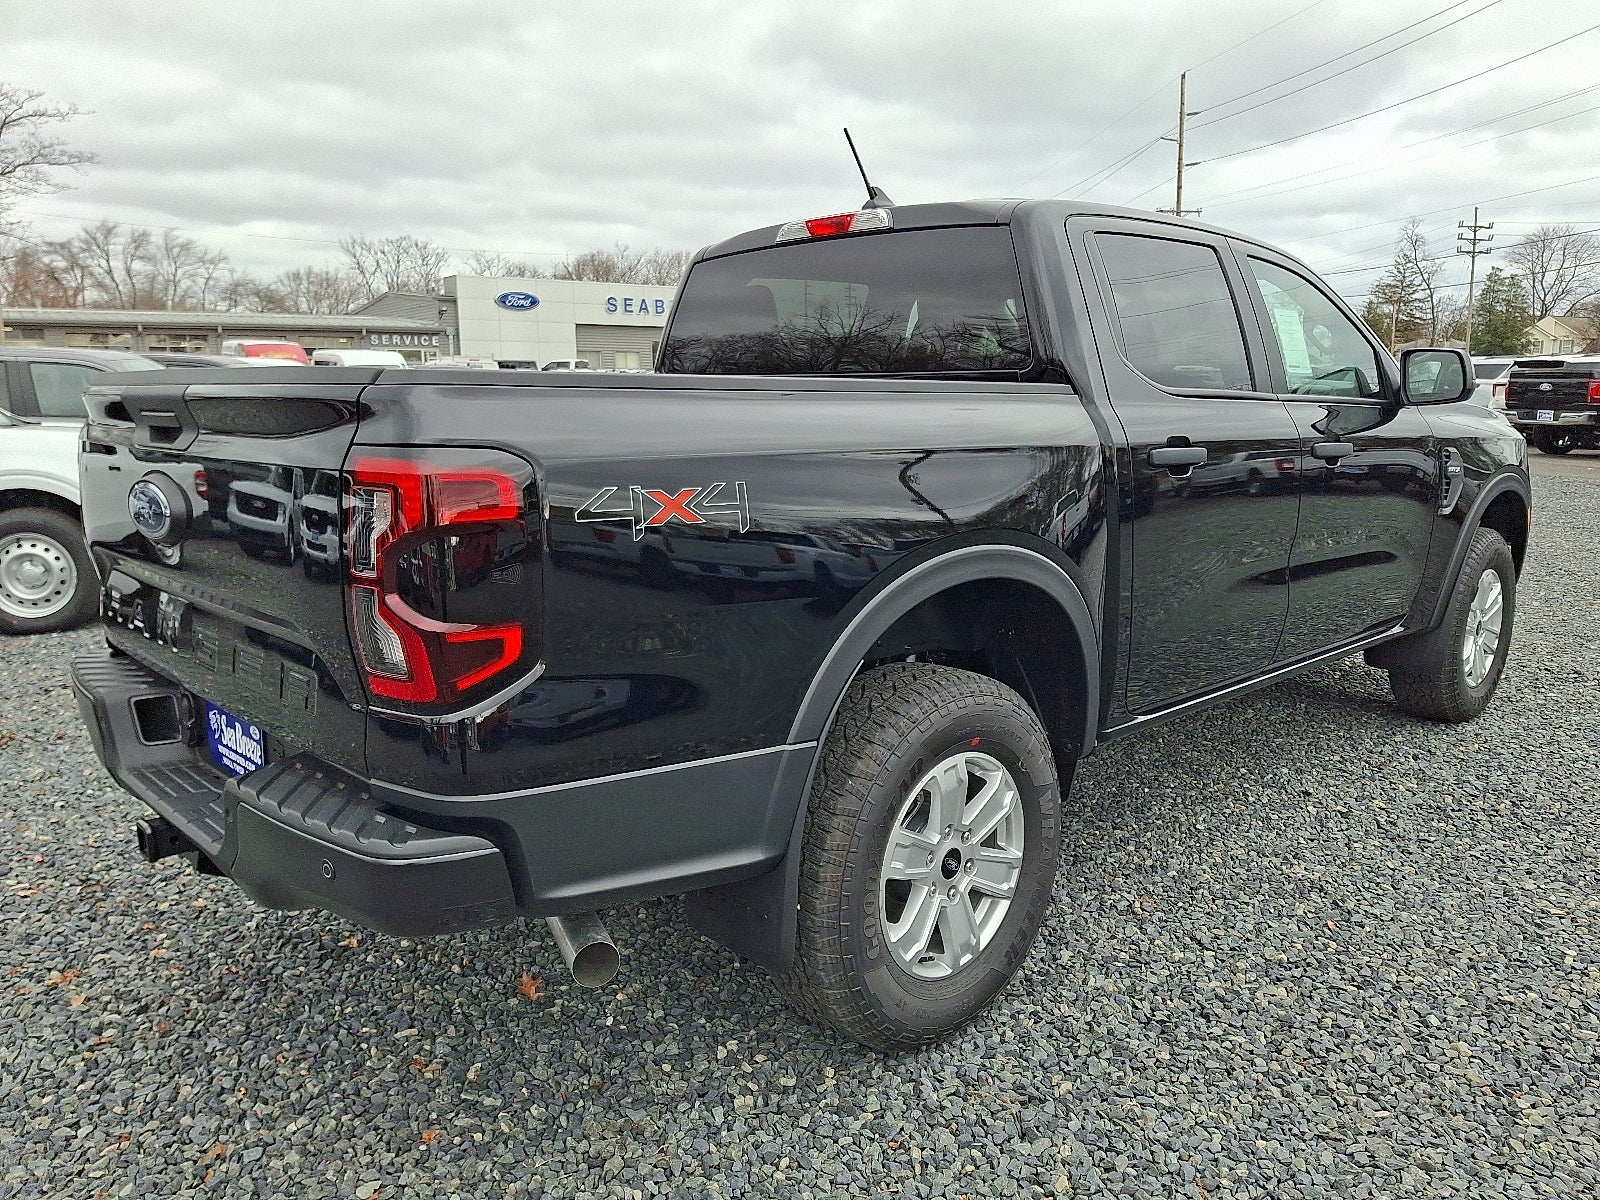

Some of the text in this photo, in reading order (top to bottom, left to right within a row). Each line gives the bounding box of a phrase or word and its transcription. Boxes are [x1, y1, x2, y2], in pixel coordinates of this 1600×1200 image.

[506, 295, 532, 306] Ford
[607, 296, 666, 315] SEAB
[370, 334, 440, 347] SERVICE
